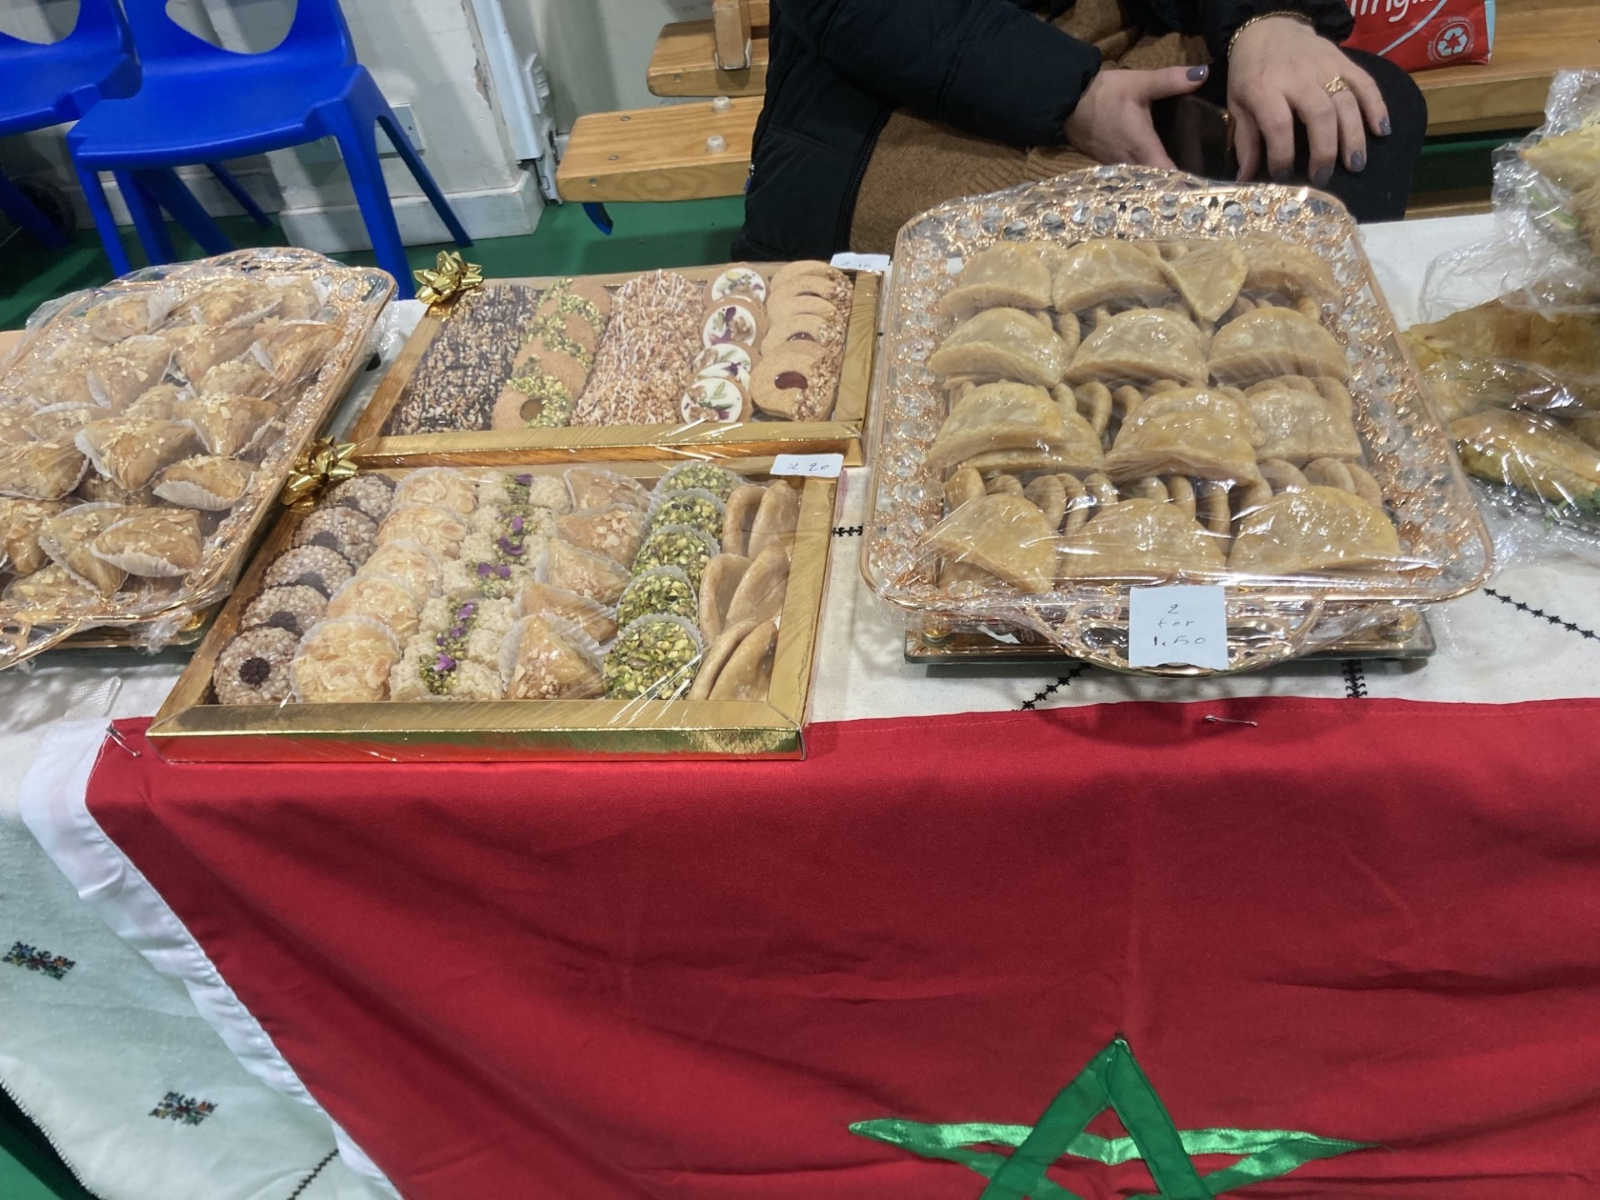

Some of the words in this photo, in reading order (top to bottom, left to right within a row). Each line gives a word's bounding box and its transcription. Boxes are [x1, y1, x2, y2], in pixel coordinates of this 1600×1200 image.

[1167, 603, 1179, 615] 2
[1158, 617, 1194, 629] for
[1153, 635, 1206, 647] 1.50
